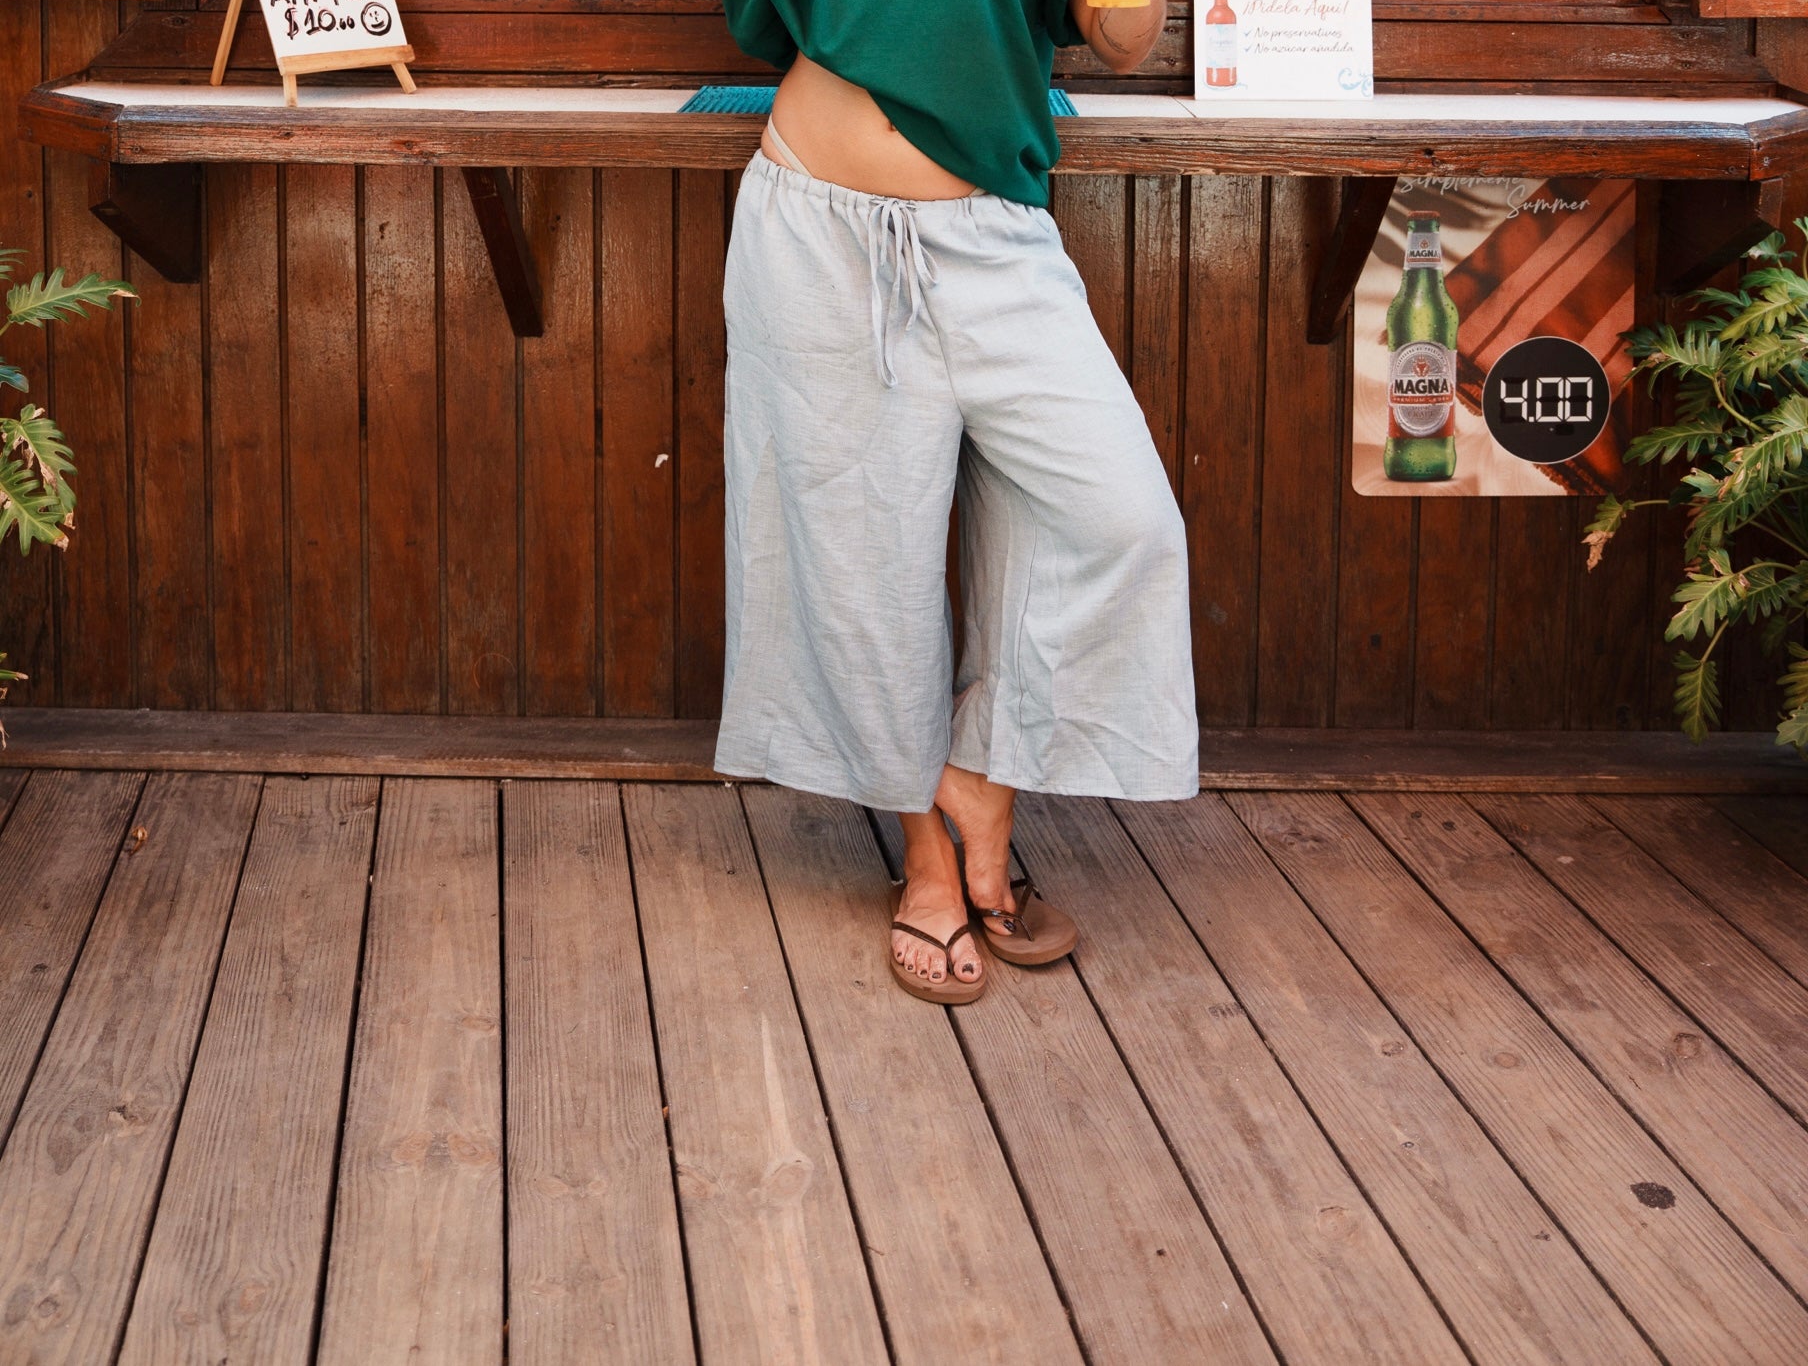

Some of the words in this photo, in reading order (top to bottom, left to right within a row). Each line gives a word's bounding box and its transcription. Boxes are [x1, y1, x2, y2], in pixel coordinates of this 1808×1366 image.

[1506, 185, 1591, 219] Summer
[1409, 249, 1439, 258] MAGNA
[1394, 378, 1449, 394] MAGNA
[1500, 376, 1593, 422] 4.00
